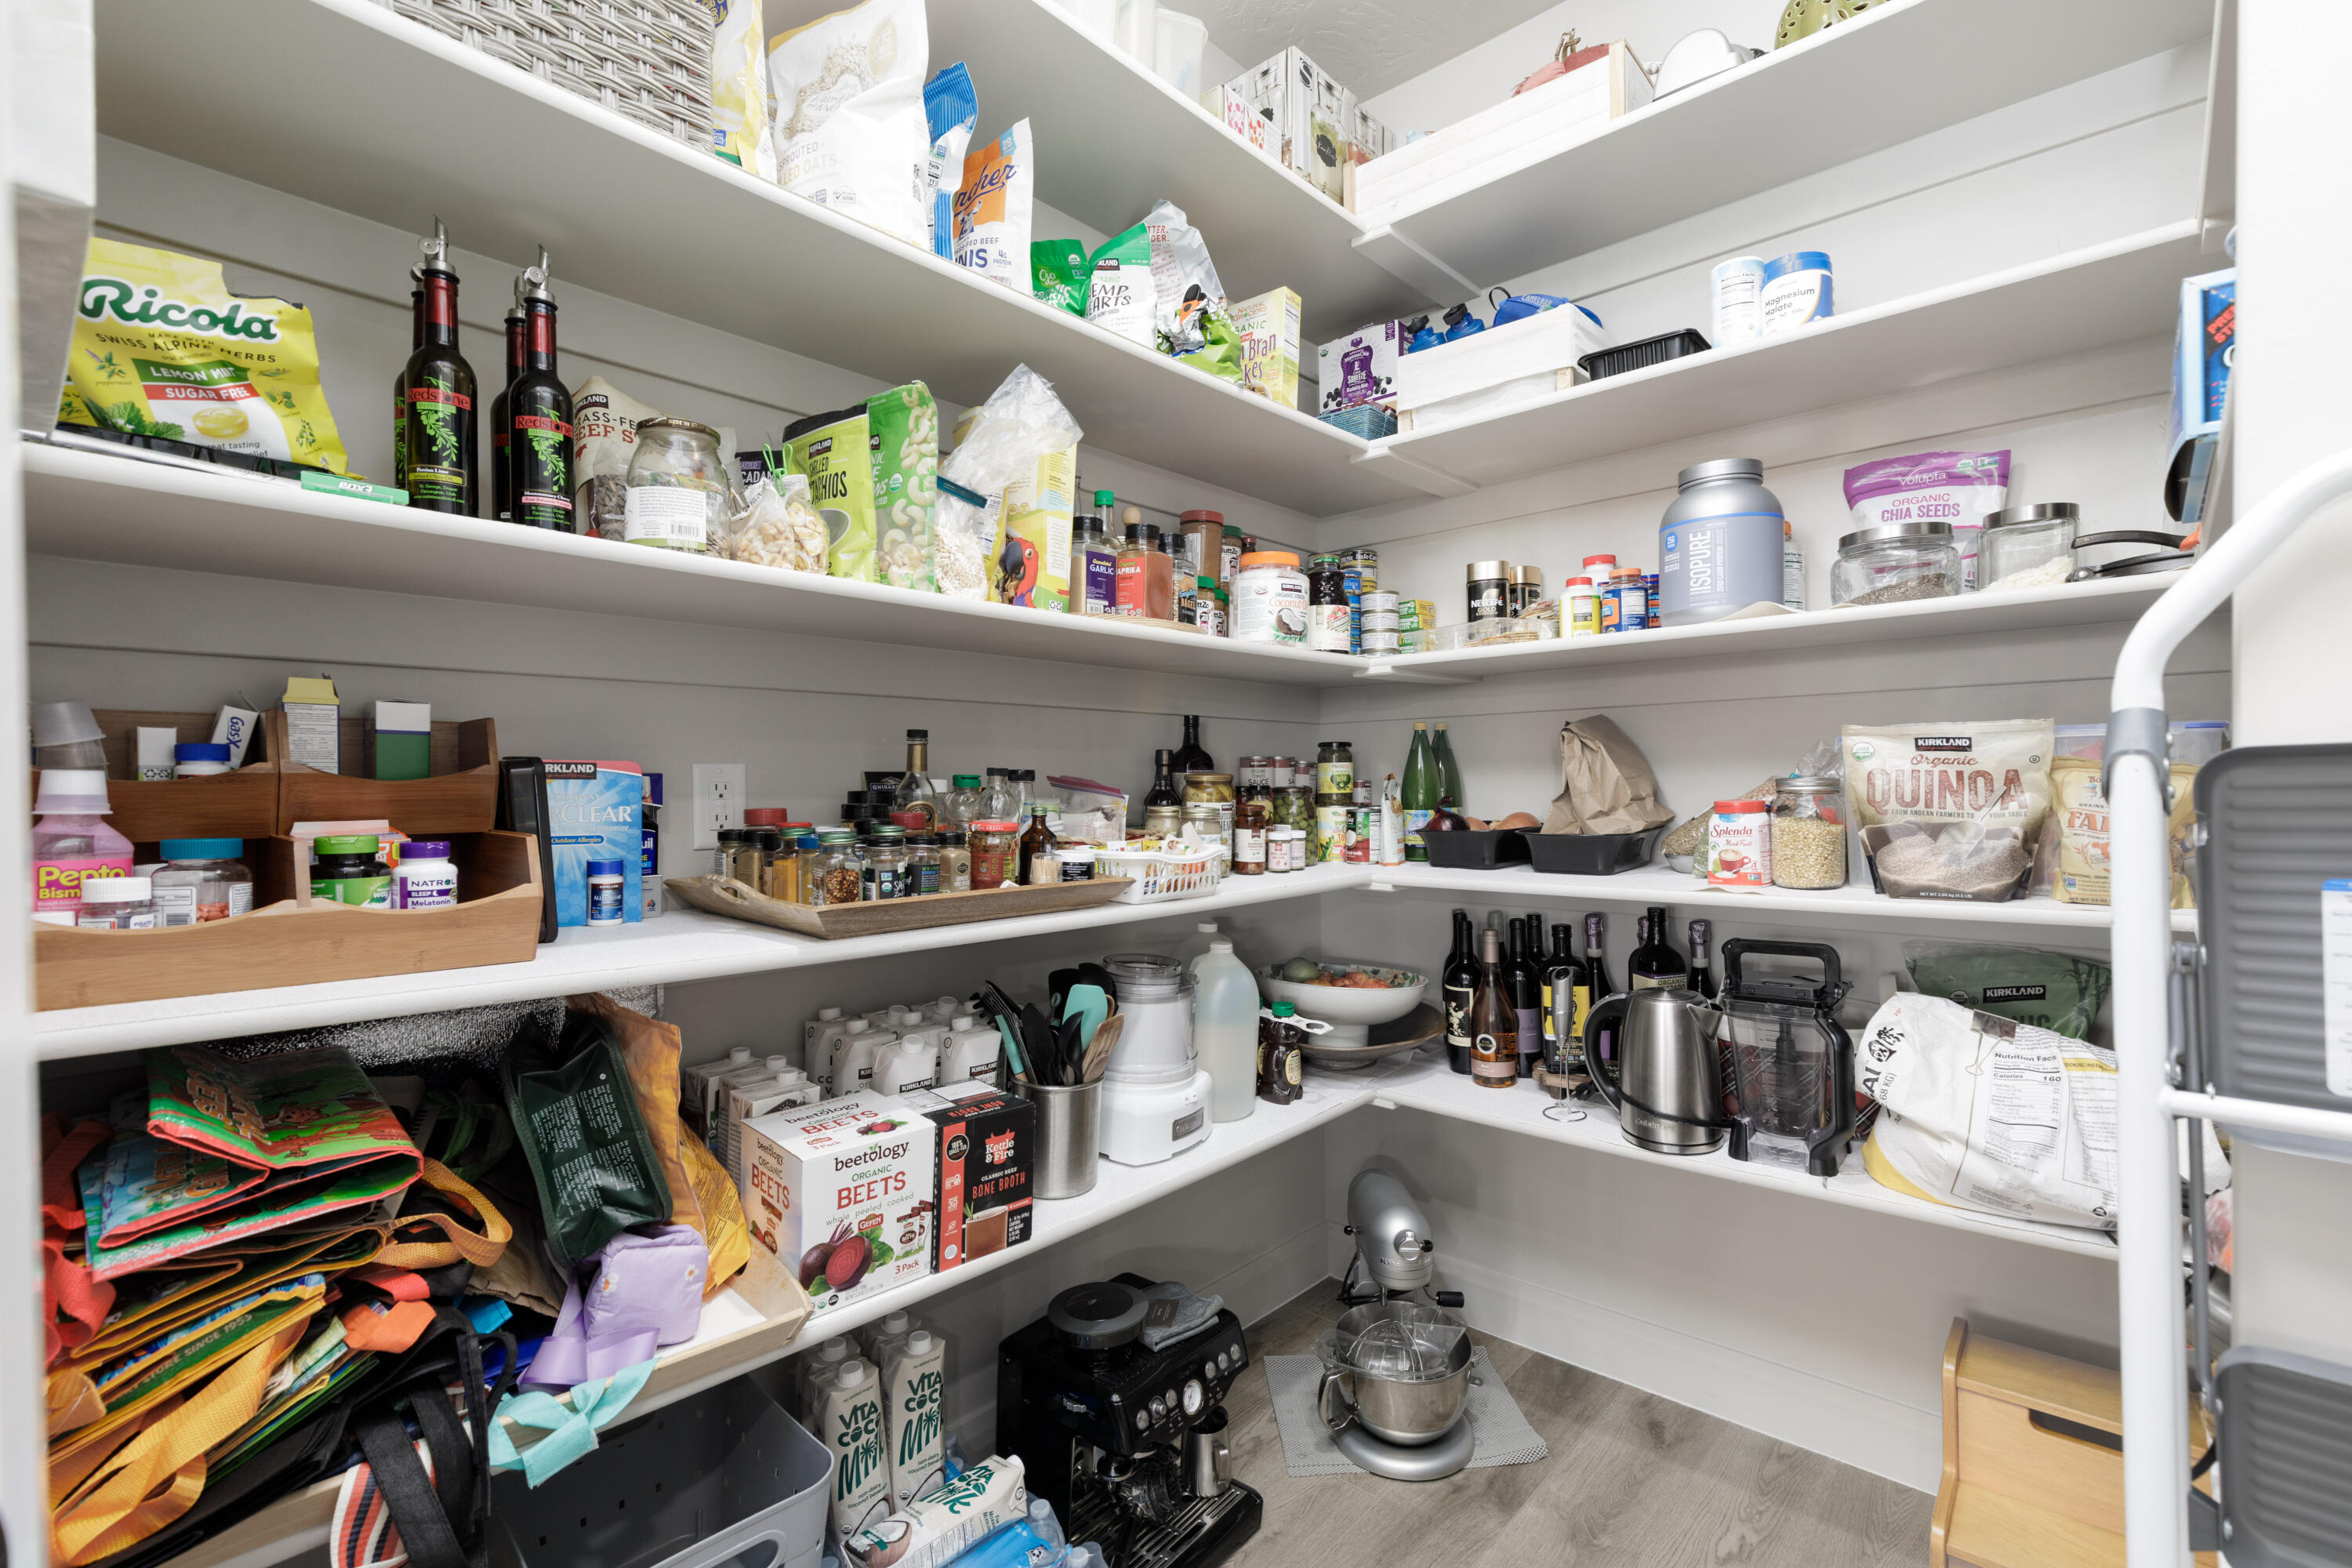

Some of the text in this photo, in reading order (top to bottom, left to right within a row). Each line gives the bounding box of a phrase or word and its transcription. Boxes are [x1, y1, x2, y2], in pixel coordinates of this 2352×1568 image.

[1003, 137, 1013, 151] 28
[779, 140, 818, 170] SPROUTED
[804, 154, 838, 174] OATS
[1765, 289, 1815, 308] Magnesium
[80, 278, 278, 340] Ricola
[1233, 307, 1267, 321] GROCERS
[1238, 302, 1265, 314] NATURAL
[1766, 303, 1793, 318] Malate
[148, 333, 215, 346] MADE WITH
[96, 333, 277, 363] SWISS ALPINE HERBS
[1249, 334, 1276, 361] Bran
[151, 366, 236, 382] LEMON MINT
[1348, 371, 1367, 383] SQUEEZE
[165, 387, 250, 400] SUGAR FREE
[517, 416, 572, 436] Redstone
[229, 440, 260, 450] tasting
[810, 439, 832, 453] KIRKLAND
[1900, 467, 1947, 486] Volupta
[1892, 493, 1951, 508] ORGANIC
[1882, 503, 1960, 522] CHIA SEEDS
[1090, 564, 1114, 575] GARLIC
[1117, 566, 1141, 575] APRIKA
[1690, 530, 1711, 596] ISOPURE
[1181, 598, 1196, 609] BAGEL
[1269, 598, 1301, 608] Coconut
[545, 764, 594, 773] RKLAND
[1911, 754, 1979, 768] Organic
[1867, 769, 2029, 815] QUINOA
[1711, 825, 1752, 838] Splenda
[39, 864, 125, 889] Pepto
[411, 879, 456, 887] NATROL
[1987, 987, 2044, 998] KIRKLAND
[1995, 1053, 2034, 1062] Nutrition
[902, 1080, 931, 1091] KIRKLAND
[785, 1102, 859, 1123] beetology
[948, 1100, 1006, 1118] BONE BROTH
[800, 1110, 879, 1134] BEETS
[808, 1112, 855, 1125] ORGANIC
[757, 1138, 783, 1166] beetology
[949, 1145, 967, 1156] GRASS-FED
[985, 1138, 1014, 1154] Kettle
[834, 1142, 909, 1171] beetology
[985, 1148, 1014, 1163] & Fire
[758, 1156, 782, 1180] ORGANIC
[852, 1164, 892, 1181] ORGANIC
[982, 1171, 1004, 1181] CLASSIC
[752, 1163, 789, 1210] BEETS
[837, 1171, 906, 1210] BEETS
[972, 1172, 1025, 1200] BONE BROTH
[826, 1192, 914, 1226] whole peeled cooked
[860, 1216, 882, 1229] GEFEN
[895, 1261, 920, 1275] 3 Pack
[184, 1333, 220, 1356] SINCE
[224, 1314, 252, 1332] 1953
[907, 1370, 942, 1396] VITA
[838, 1400, 879, 1430] VITA
[838, 1412, 881, 1447] COCO
[917, 1452, 939, 1465] non-dairy
[908, 1464, 927, 1474] coconut
[858, 1483, 881, 1499] non-dairy
[848, 1496, 868, 1508] coconut
